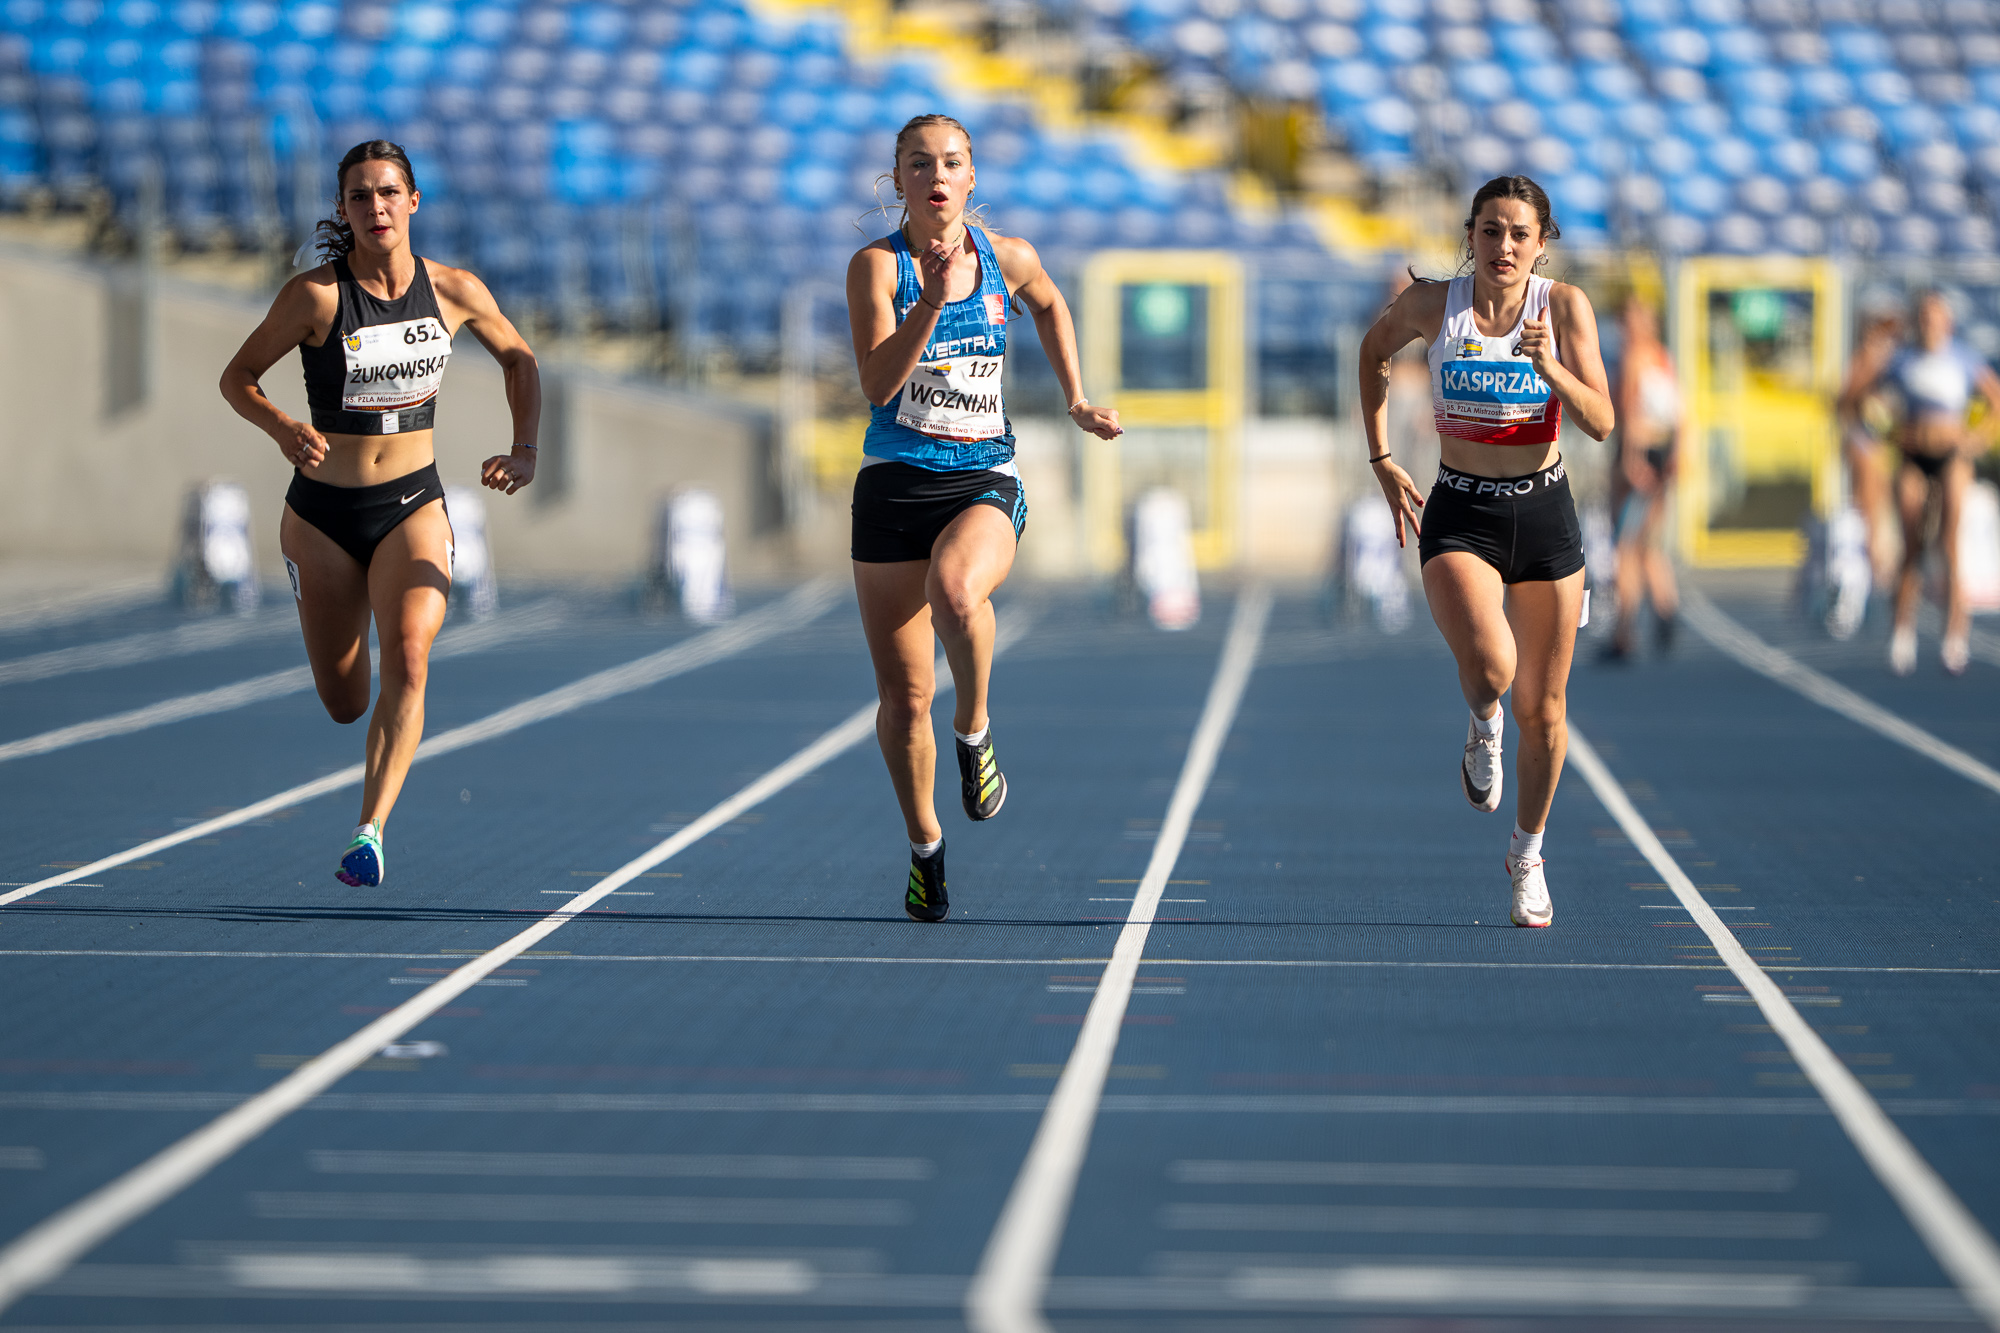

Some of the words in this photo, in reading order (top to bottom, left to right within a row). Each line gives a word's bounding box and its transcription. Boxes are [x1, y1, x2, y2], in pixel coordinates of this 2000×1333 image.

[404, 324, 441, 344] 652
[924, 334, 996, 359] VECTRA
[350, 355, 444, 384] ŻUKOWSKA
[969, 361, 998, 378] 117
[1444, 370, 1548, 394] KASPRZAK
[377, 394, 415, 403] Mistrzostwa
[911, 382, 998, 413] WOŹNIAK
[1474, 408, 1511, 416] Mistrzostwa
[899, 416, 908, 424] 55.
[911, 420, 927, 428] PZLA
[929, 424, 968, 433] Mistrzostwa
[1476, 479, 1534, 496] PRO
[287, 561, 297, 592] 6
